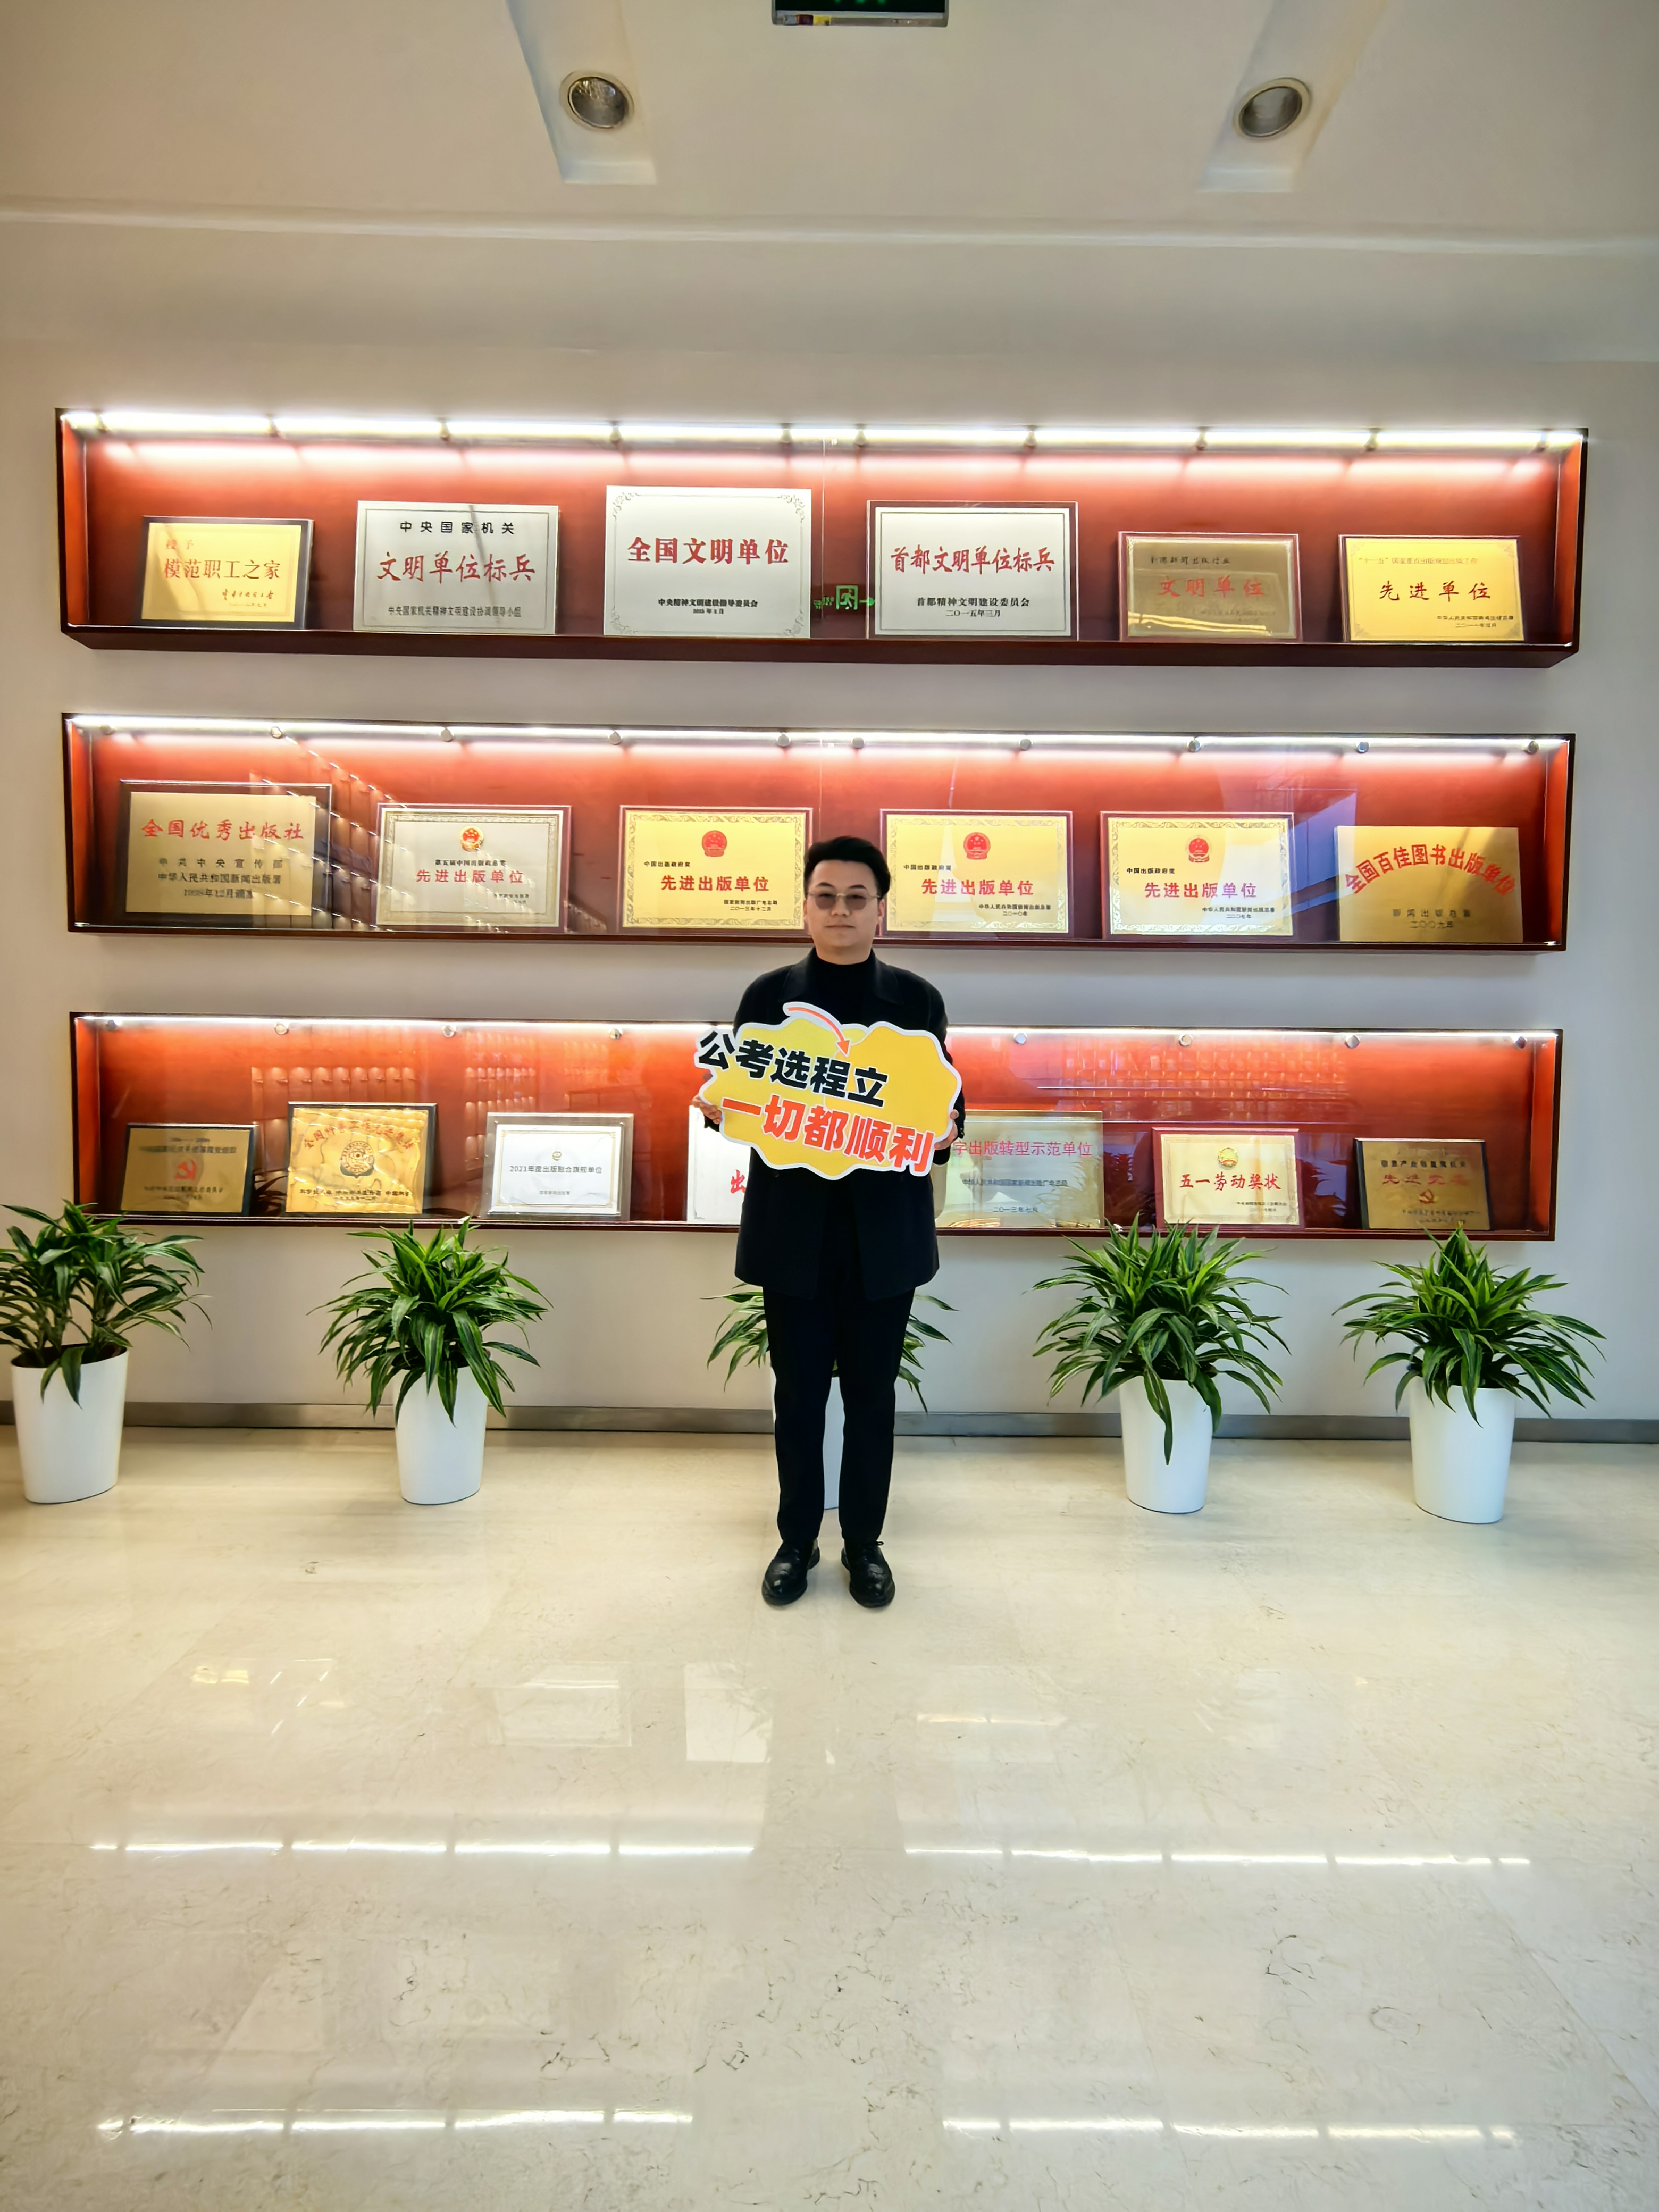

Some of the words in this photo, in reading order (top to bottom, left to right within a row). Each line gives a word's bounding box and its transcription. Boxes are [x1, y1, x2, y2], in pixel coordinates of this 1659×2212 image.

[400, 521, 514, 534] 中央国家机关
[627, 537, 789, 565] 全国文明单位
[891, 545, 1055, 574] 首都文明单位标兵
[164, 558, 281, 579] 模范职工之家
[376, 551, 535, 584] 文明单位标兵
[1158, 575, 1265, 598] 文明单位
[1379, 581, 1491, 602] 先进单位
[917, 597, 1030, 607] 首都精神文明建设委员会
[141, 819, 304, 841] 全国优秀出版社
[416, 869, 524, 884] 先进出版单位
[1345, 843, 1516, 896] 全国百佳图书出版单位
[661, 875, 769, 892] 先进出版单位
[921, 878, 1034, 896] 先进出版单位
[1144, 882, 1257, 899] 先进出版单位
[698, 1030, 888, 1108] 公考选程立
[722, 1094, 935, 1173] 一切都顺利
[952, 1140, 1093, 1157] 字出版转型示范单位
[1179, 1171, 1281, 1191] 五一劳动奖状
